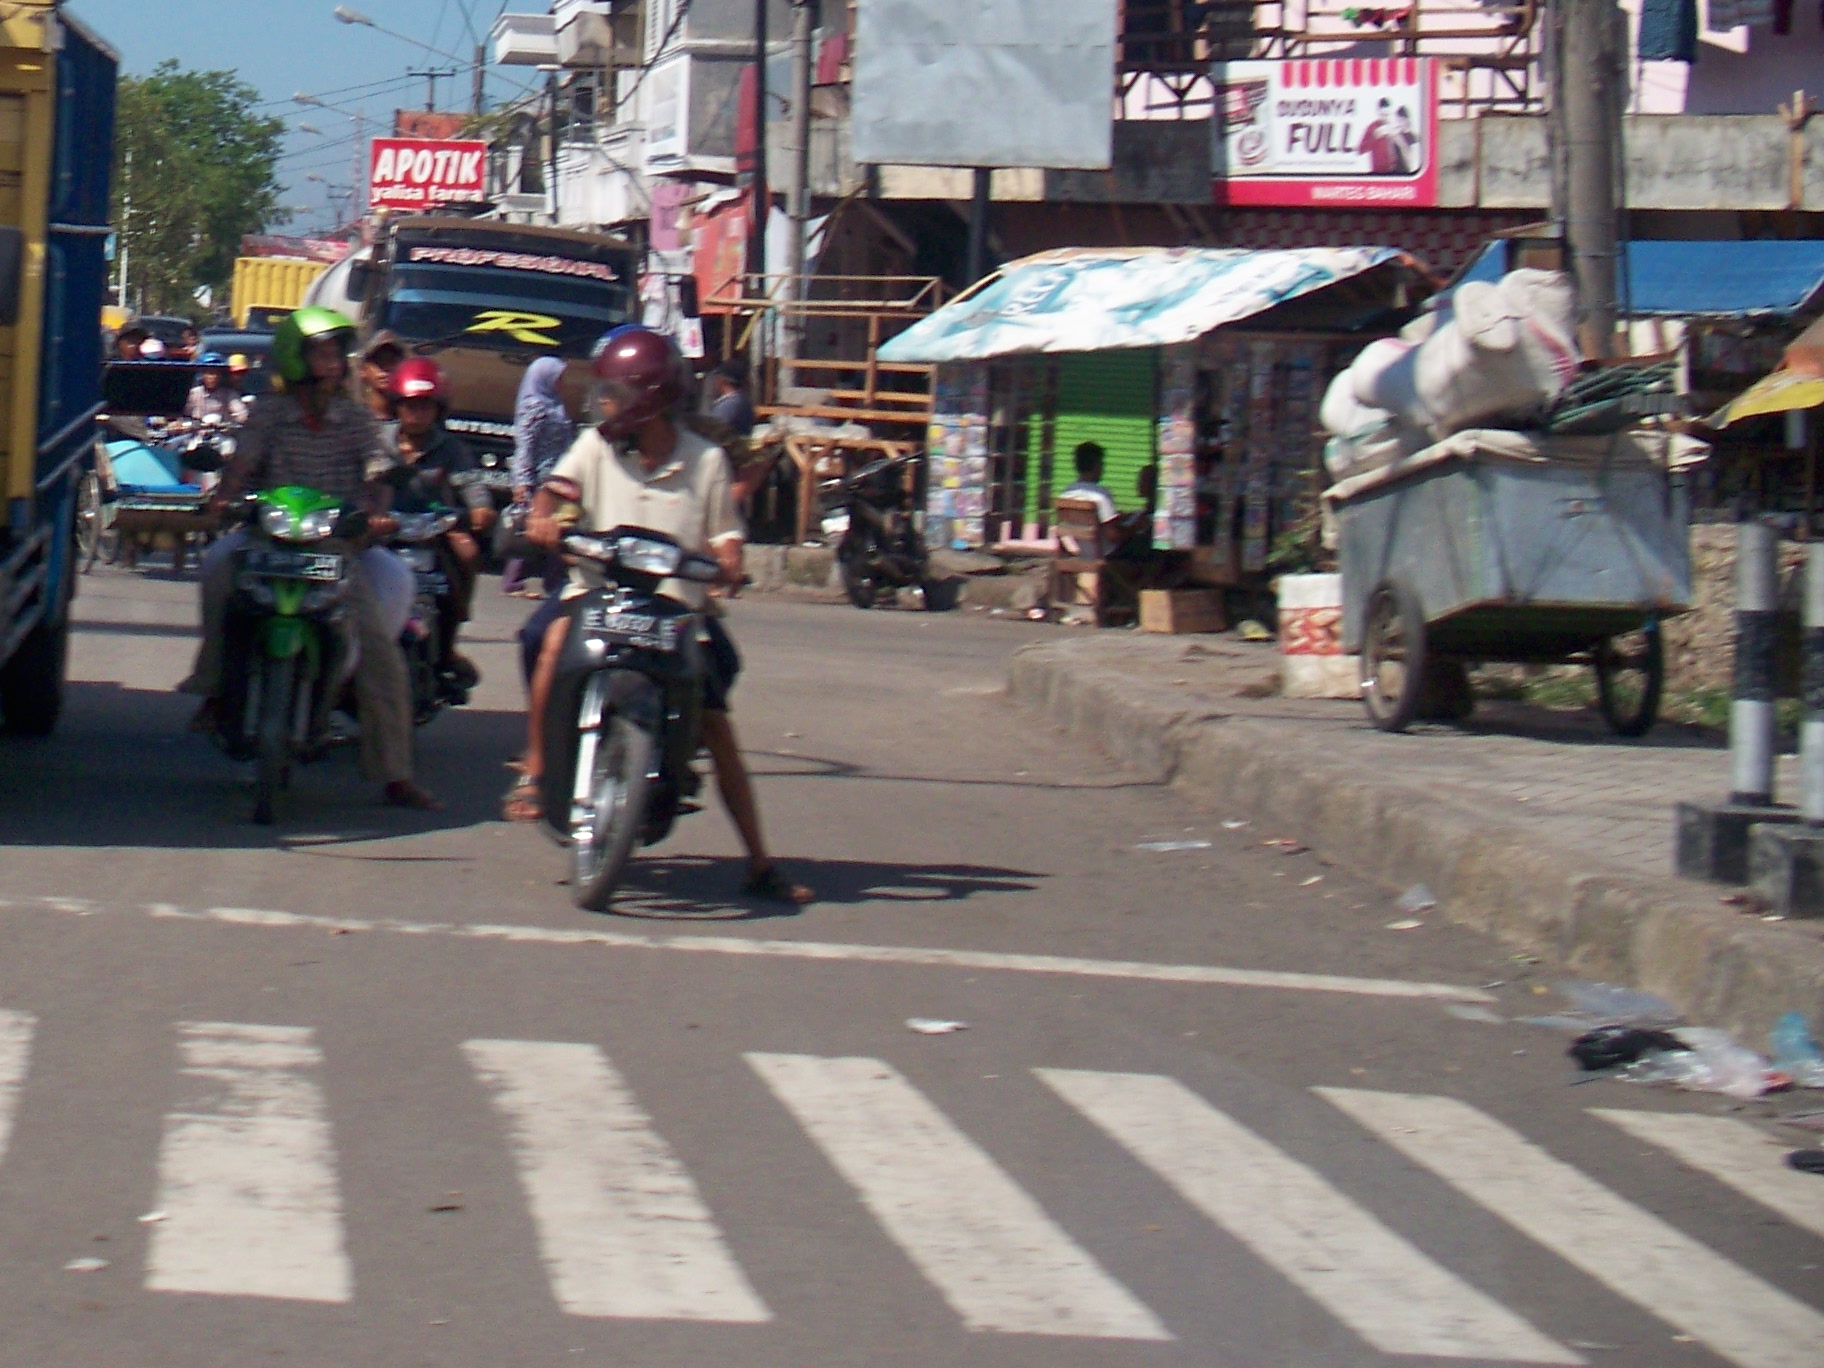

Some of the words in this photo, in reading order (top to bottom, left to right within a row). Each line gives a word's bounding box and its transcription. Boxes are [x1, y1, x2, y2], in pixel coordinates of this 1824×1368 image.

[1288, 121, 1354, 154] FULL
[373, 148, 482, 184] APOTIK
[427, 185, 484, 202] farma
